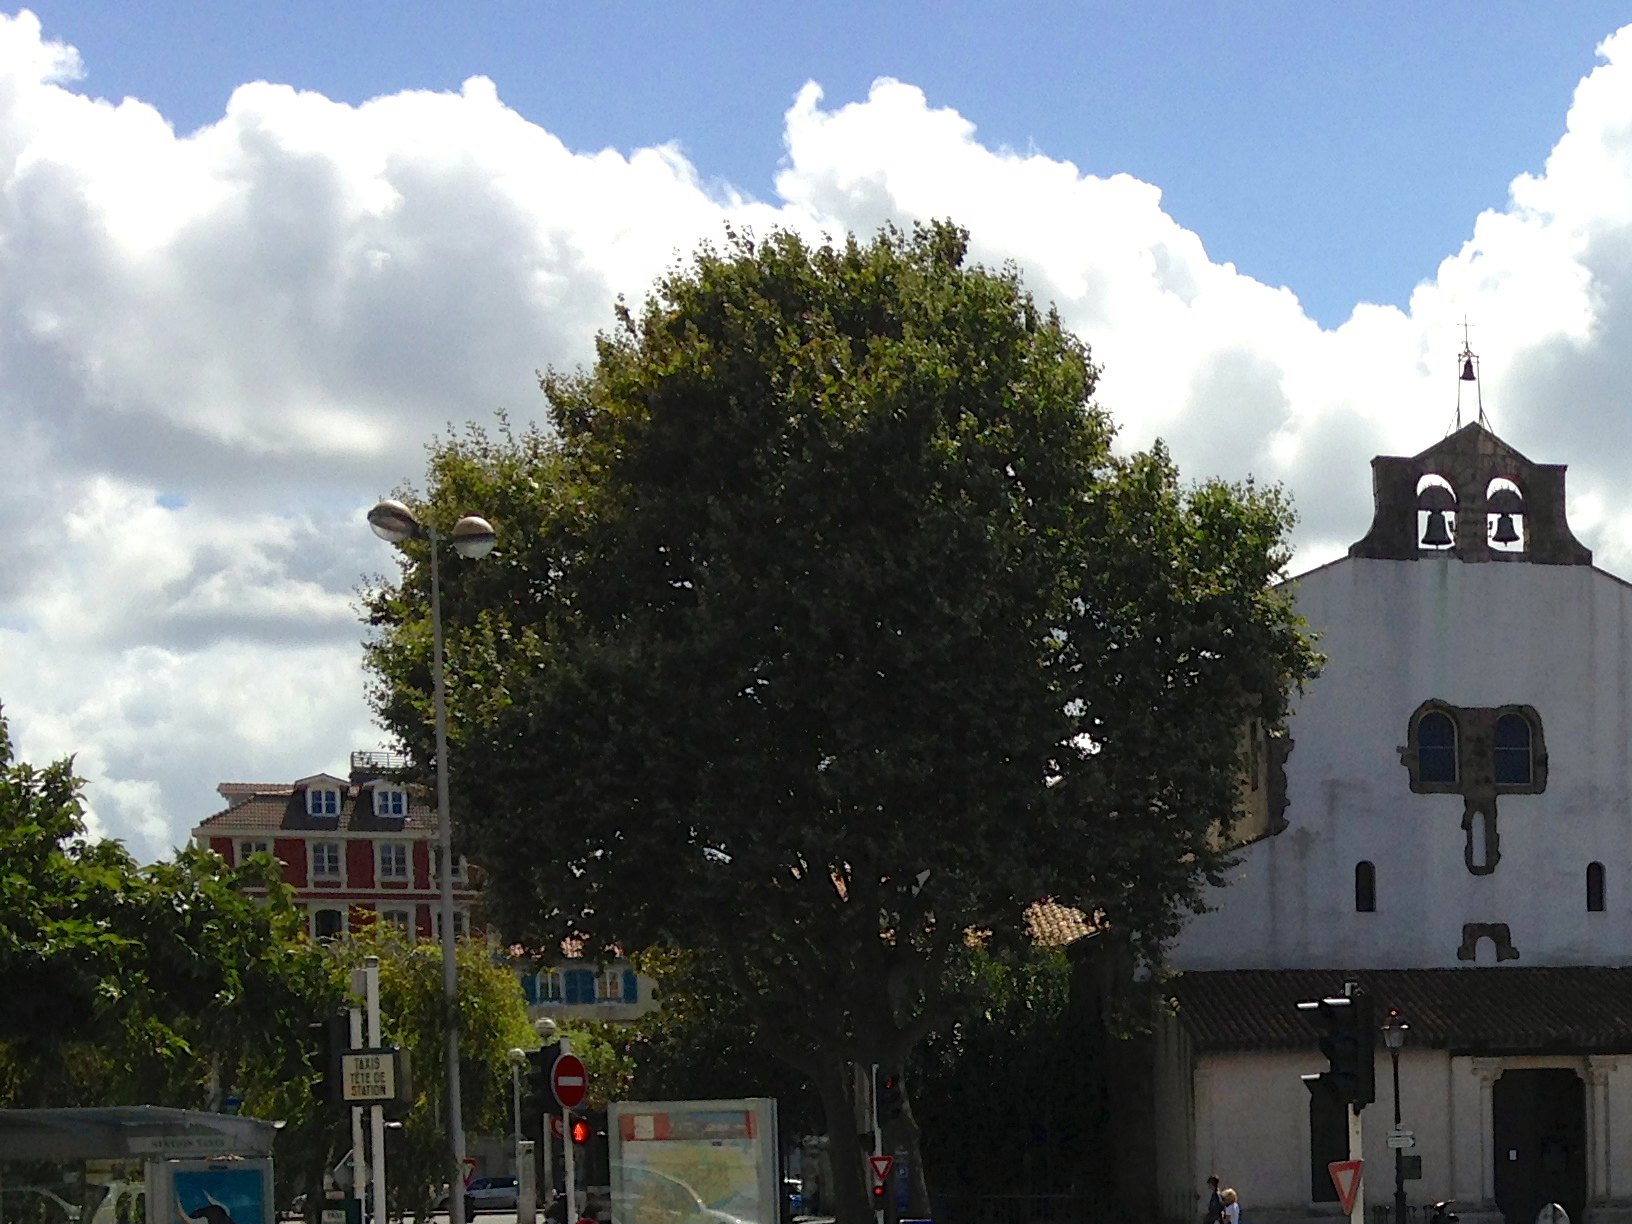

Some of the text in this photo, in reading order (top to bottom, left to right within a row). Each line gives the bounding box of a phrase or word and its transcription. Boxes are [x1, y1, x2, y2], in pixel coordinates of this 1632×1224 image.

[354, 1056, 380, 1070] TAXIS
[373, 1071, 386, 1084] DE
[351, 1084, 386, 1097] STATION
